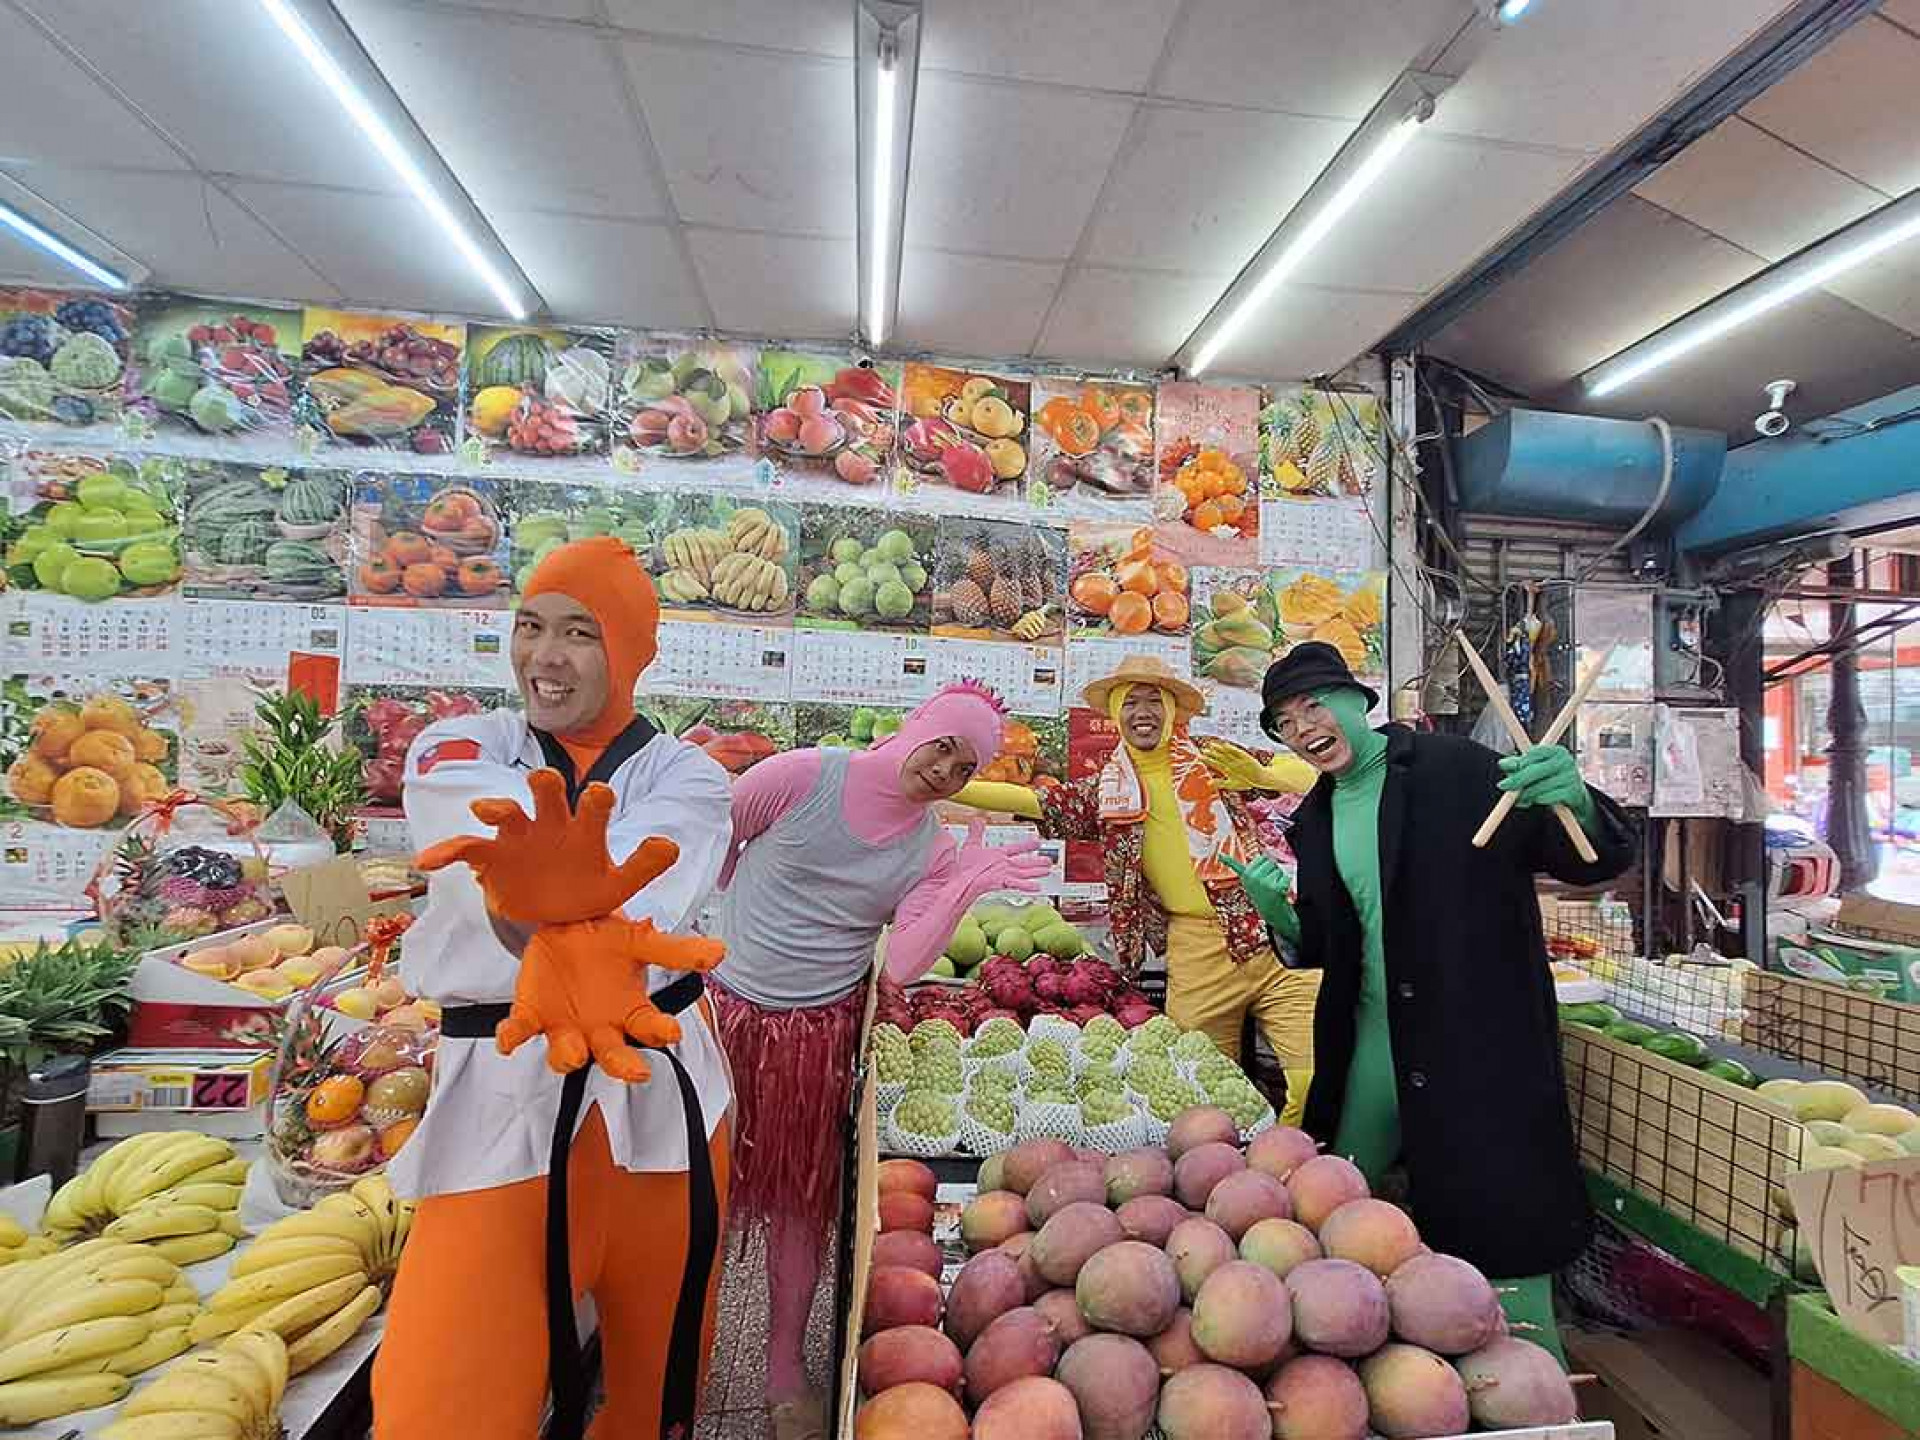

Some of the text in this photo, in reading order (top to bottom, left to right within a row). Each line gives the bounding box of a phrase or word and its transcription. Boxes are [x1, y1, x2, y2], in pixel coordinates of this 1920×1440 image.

[311, 606, 326, 620] 05
[474, 611, 489, 625] 12
[10, 822, 23, 839] 2
[195, 1074, 245, 1107] 22
